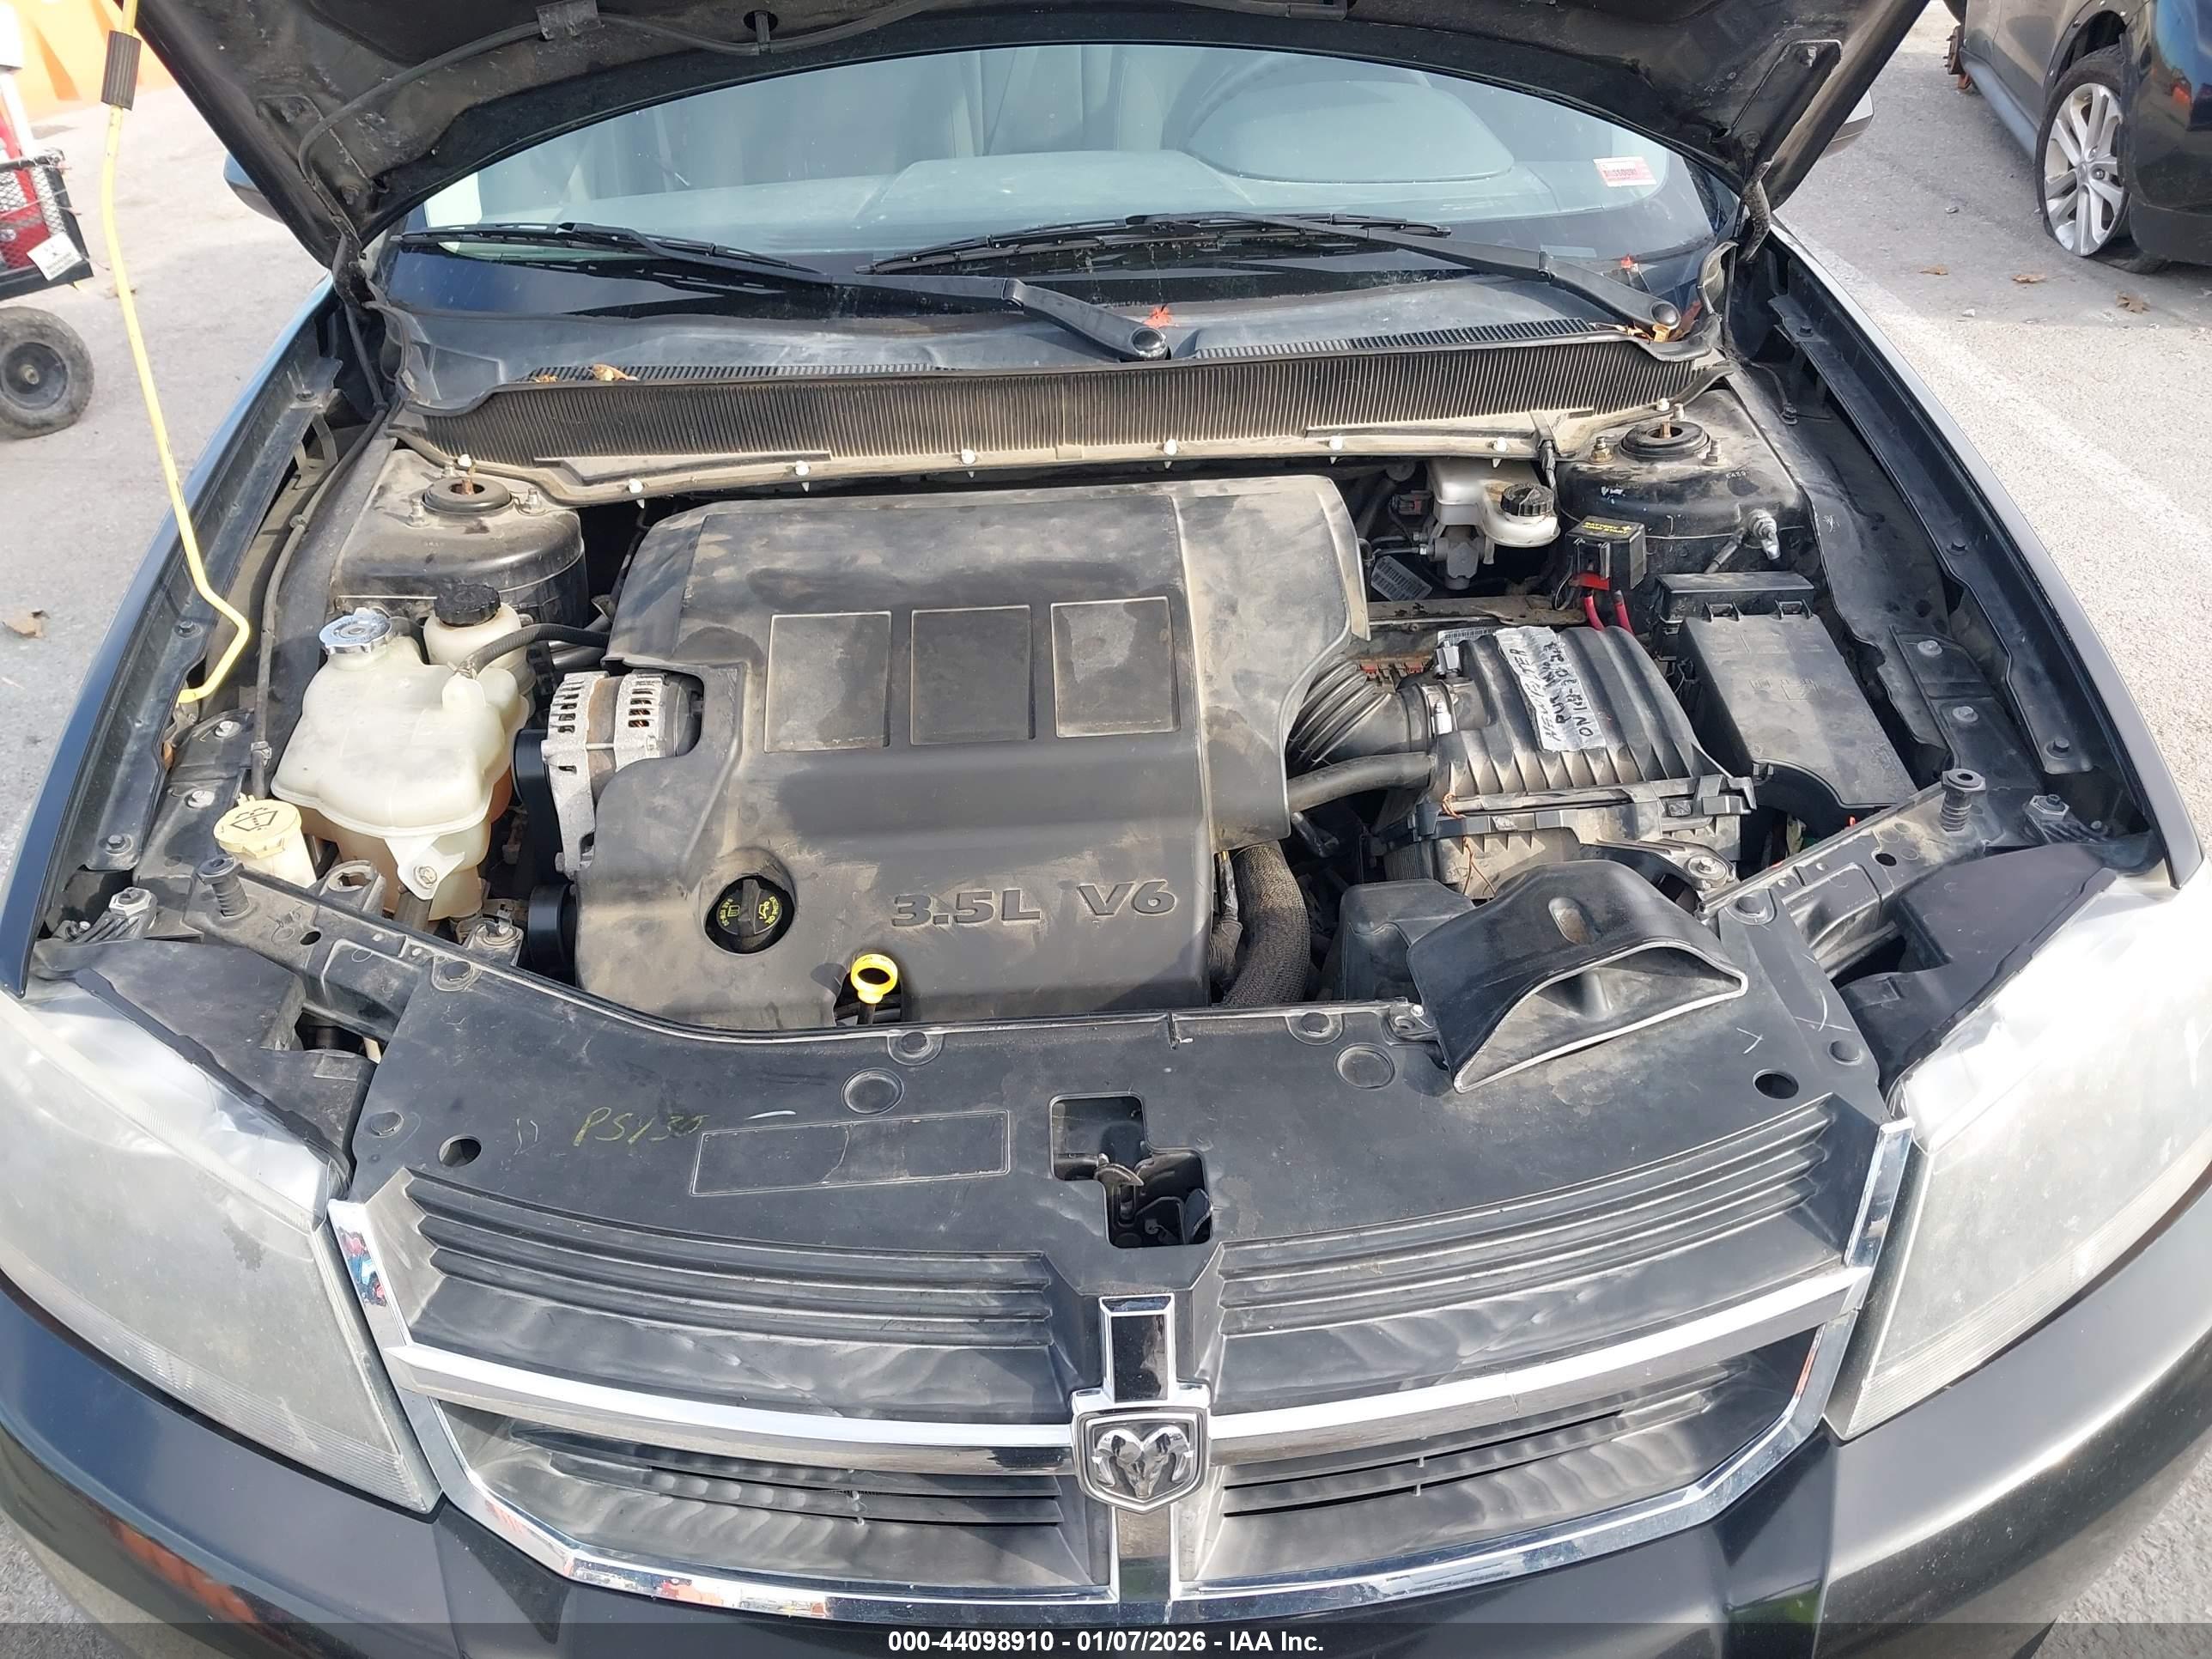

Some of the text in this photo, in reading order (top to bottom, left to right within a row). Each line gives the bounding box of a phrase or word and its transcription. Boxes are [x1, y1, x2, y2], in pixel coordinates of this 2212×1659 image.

[1573, 716, 1594, 736] ON
[890, 878, 1176, 927] 3.5L V6
[765, 915, 775, 924] OIL
